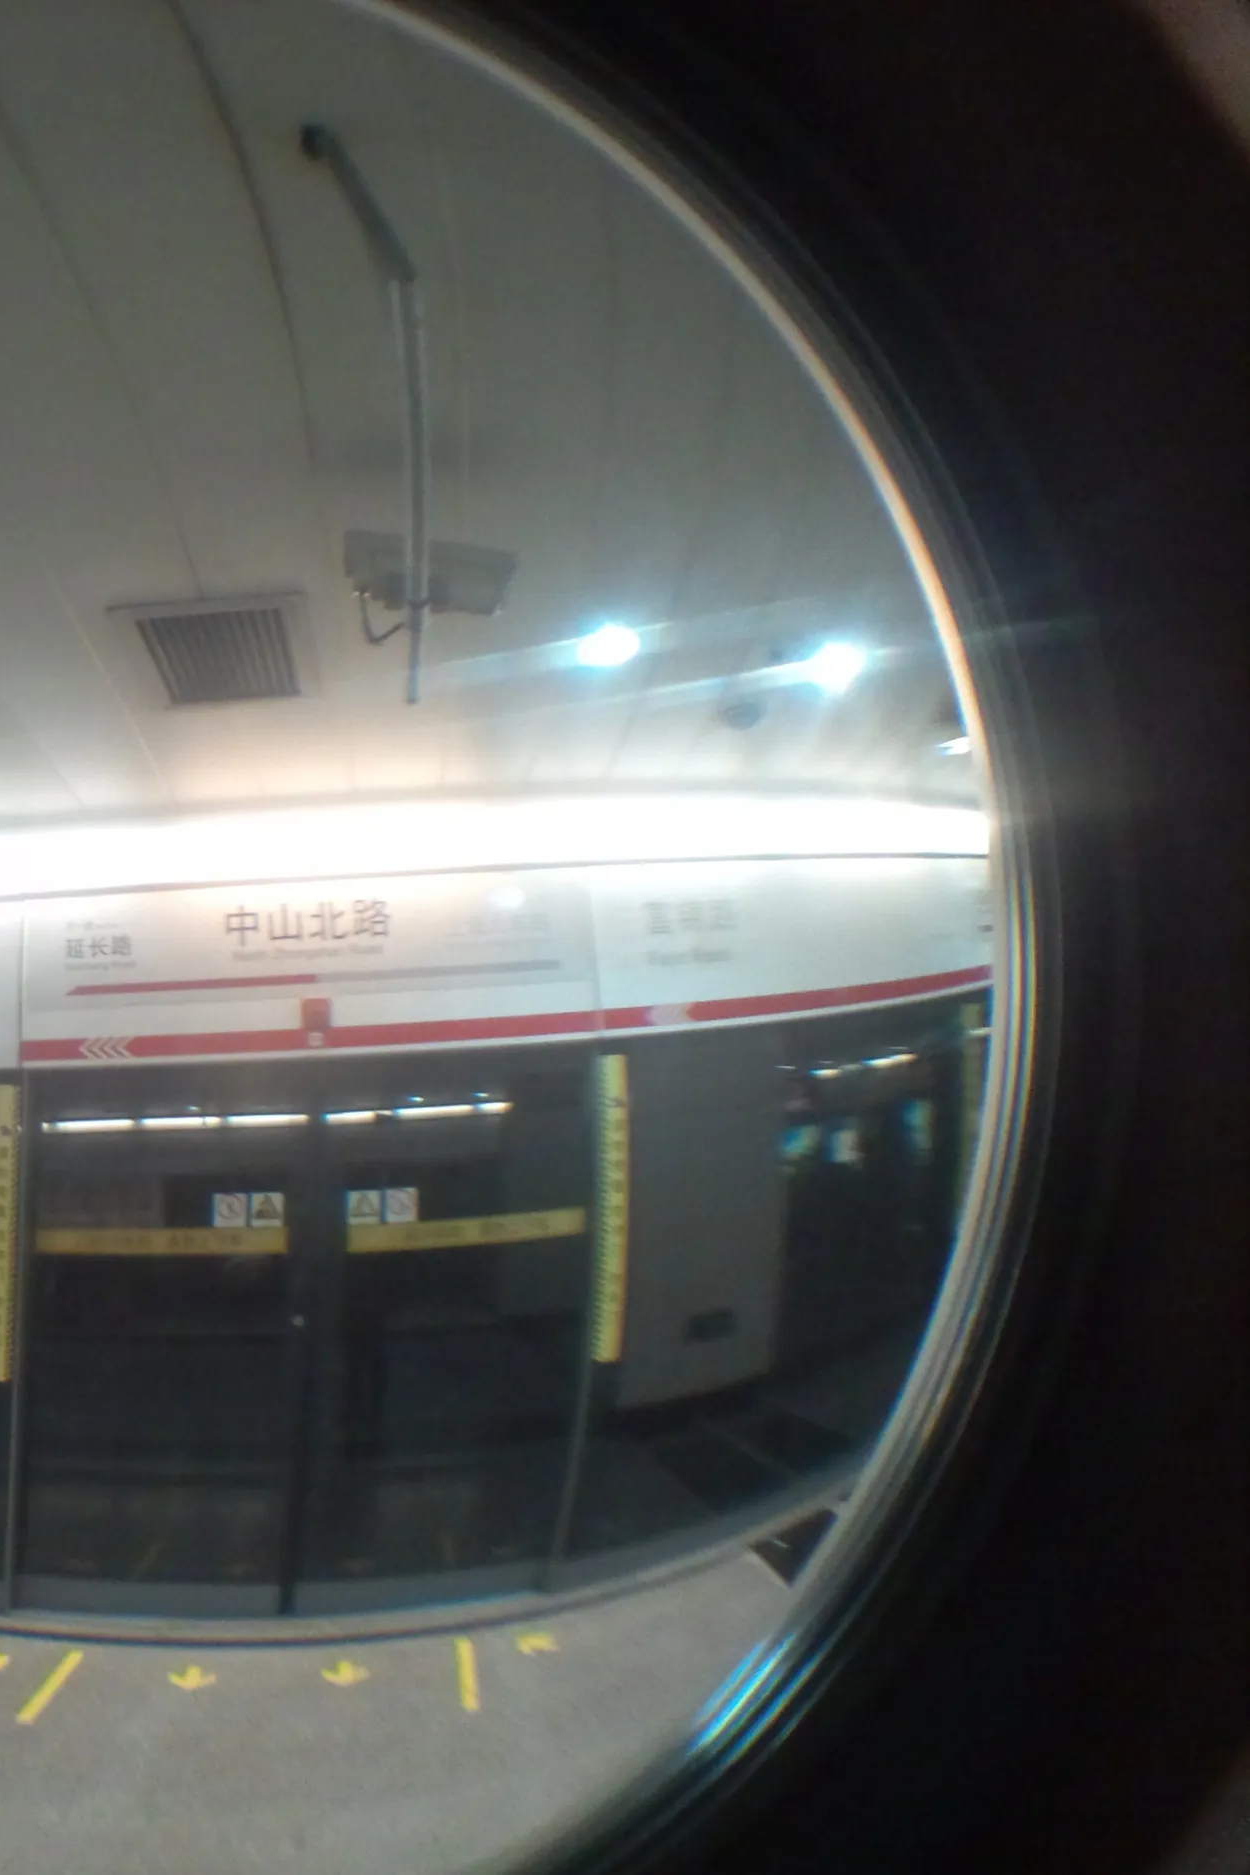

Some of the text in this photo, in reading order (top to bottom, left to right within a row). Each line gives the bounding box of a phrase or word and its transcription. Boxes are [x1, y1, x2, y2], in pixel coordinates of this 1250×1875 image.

[224, 898, 390, 946] 中山北路
[65, 935, 132, 958] 延长路
